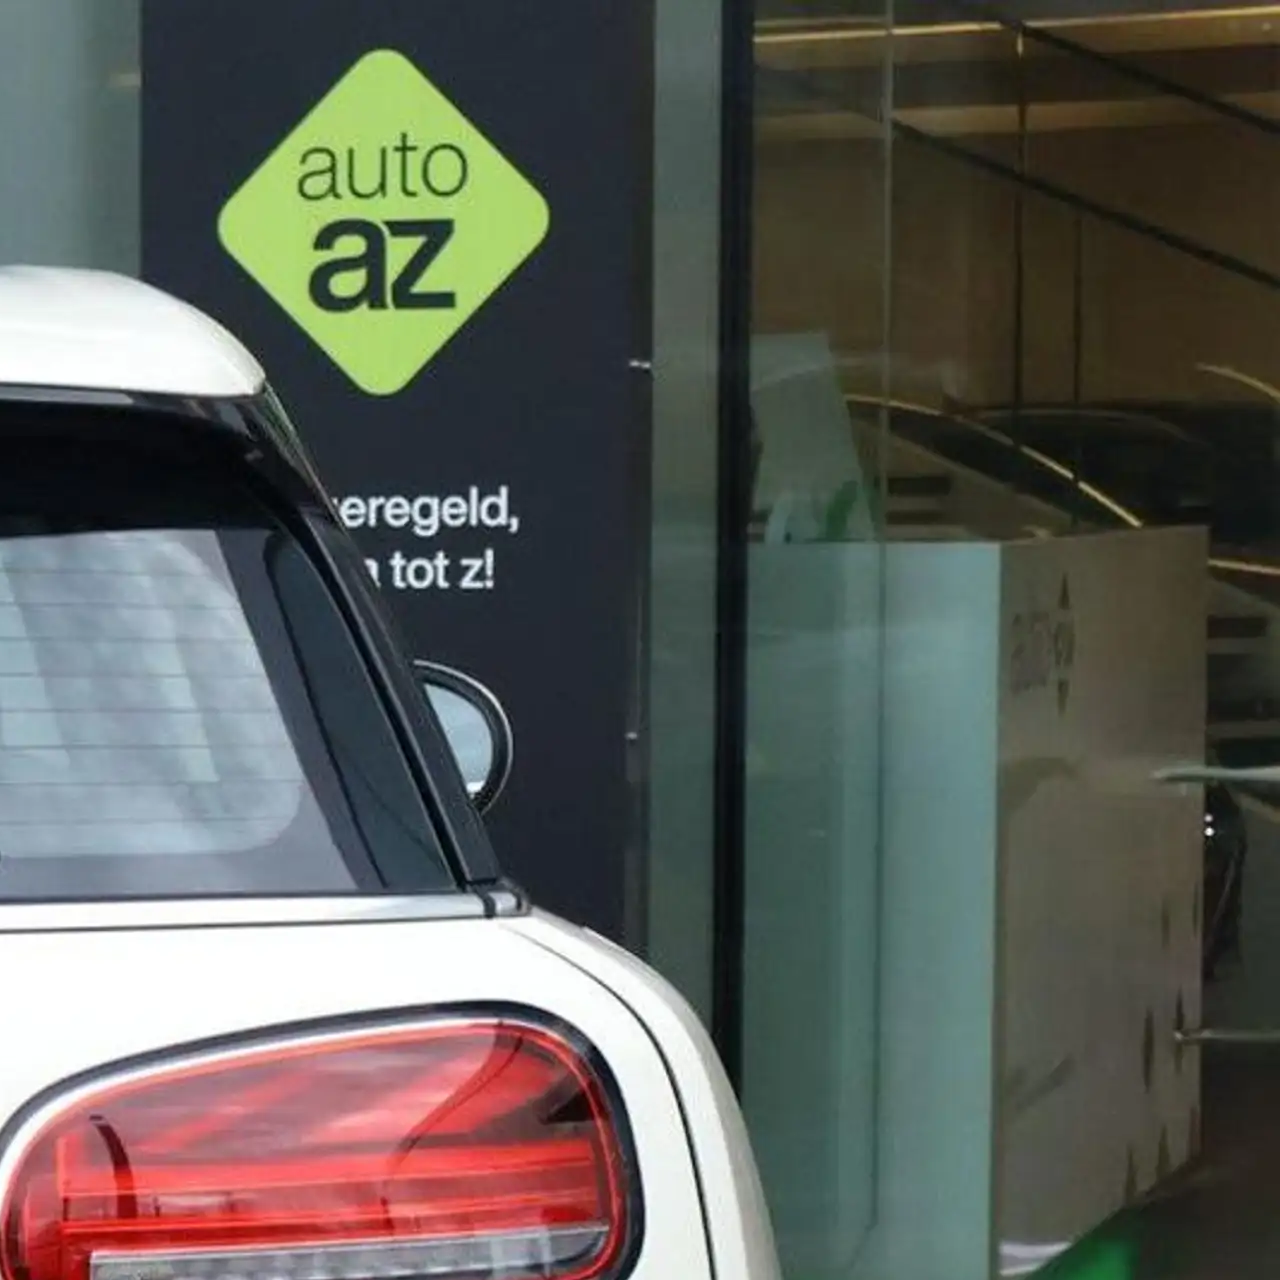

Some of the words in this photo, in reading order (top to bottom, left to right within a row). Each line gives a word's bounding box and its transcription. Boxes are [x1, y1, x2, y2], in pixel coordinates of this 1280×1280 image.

[296, 132, 469, 200] auto
[307, 217, 457, 314] az
[332, 484, 519, 538] eregeld,
[389, 550, 450, 590] tot
[459, 547, 495, 590] z!
